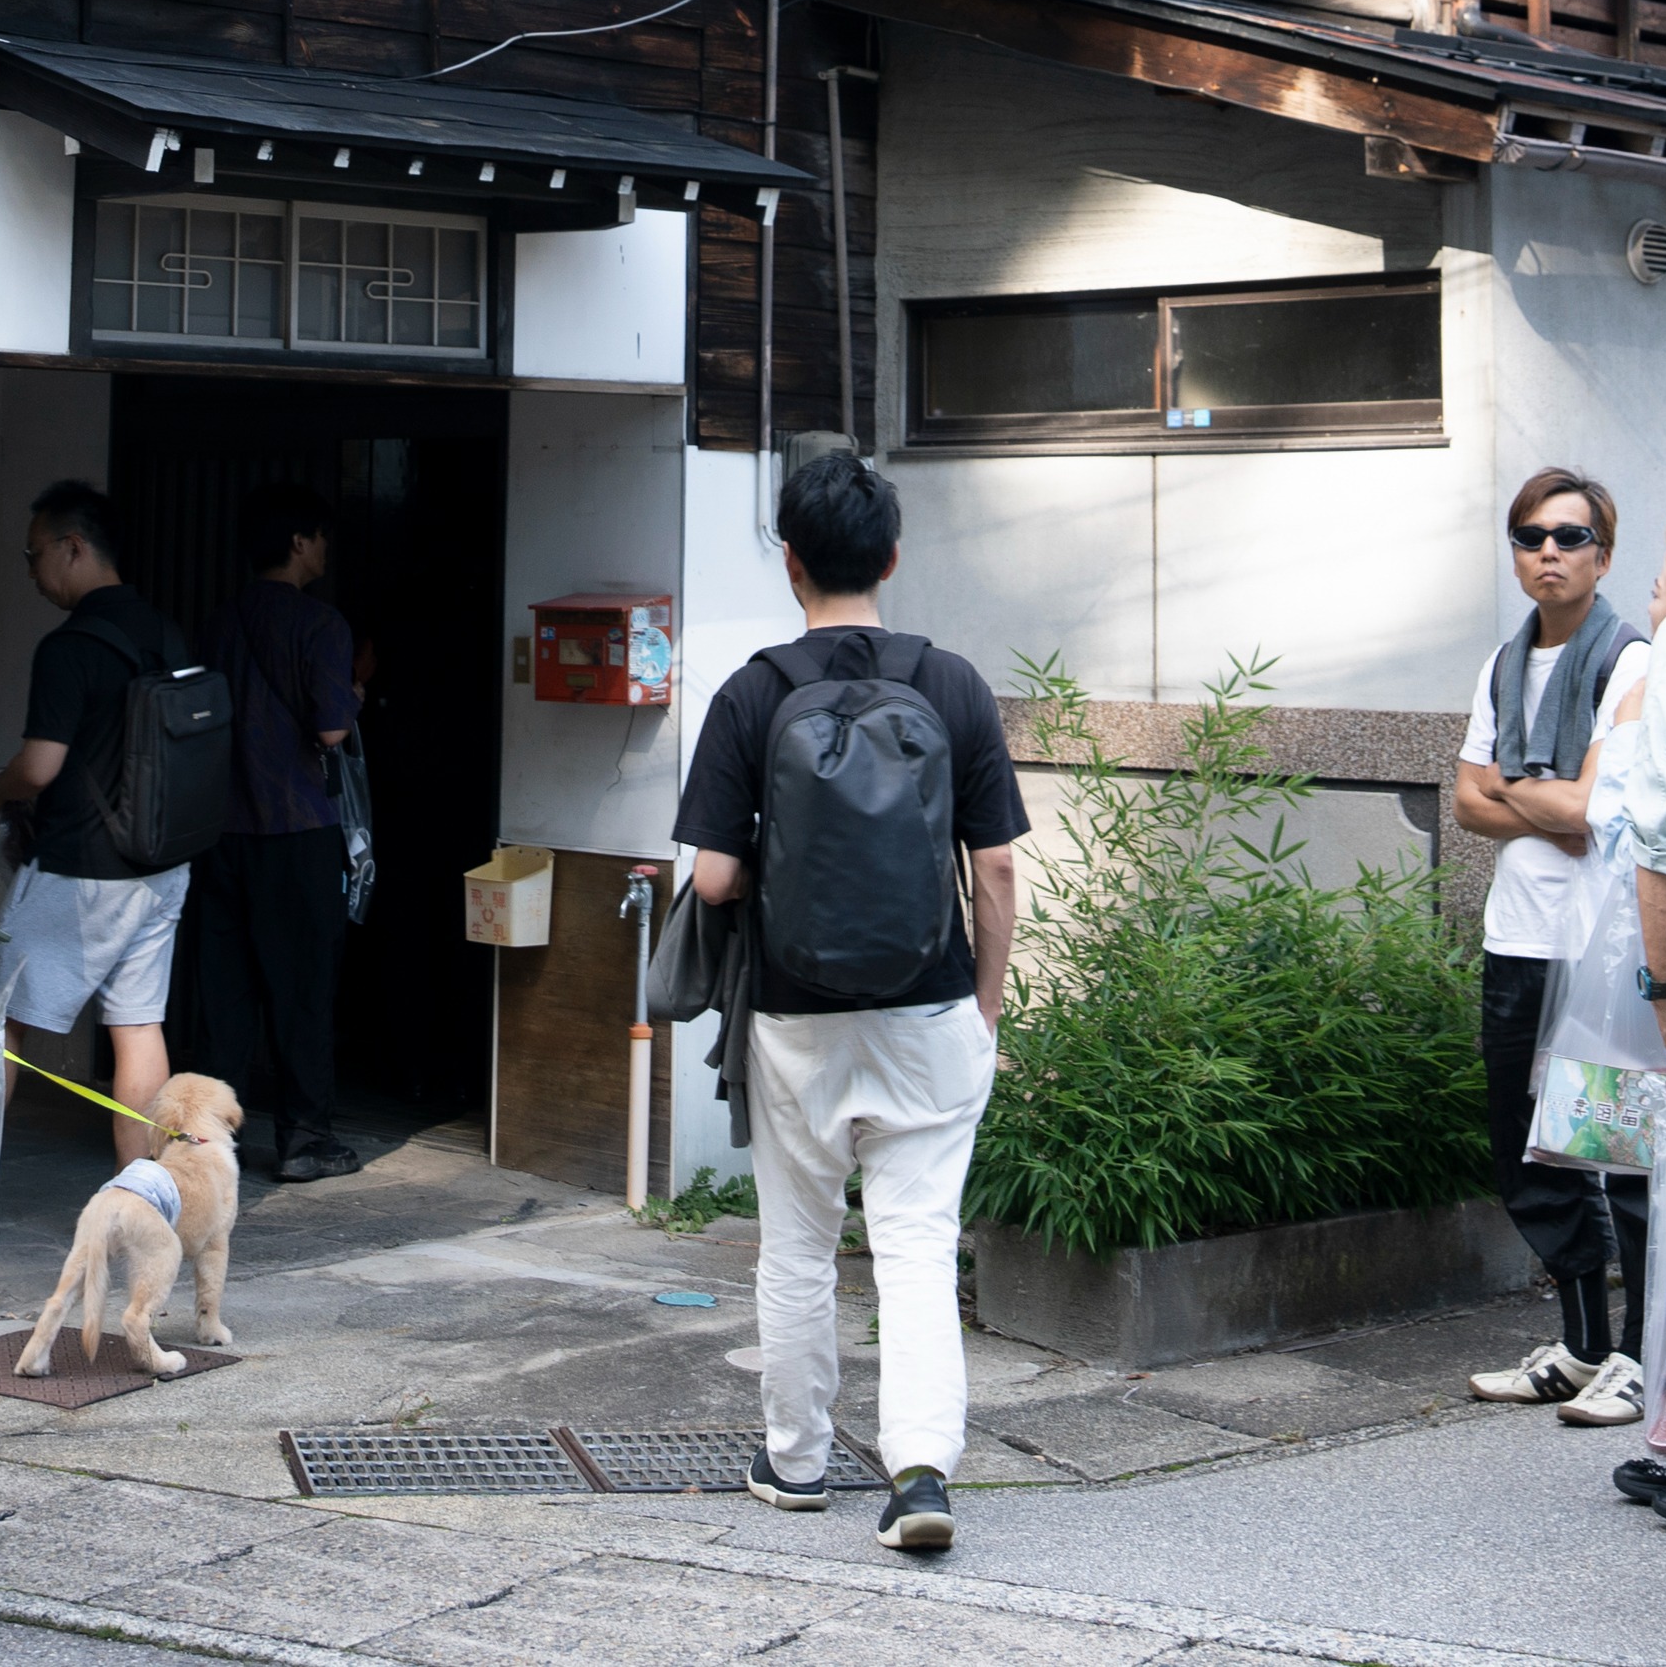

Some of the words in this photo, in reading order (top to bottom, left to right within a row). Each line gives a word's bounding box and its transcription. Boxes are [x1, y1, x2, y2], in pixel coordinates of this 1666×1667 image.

[471, 921, 507, 942] 牛乳
[1572, 1097, 1640, 1129] 神岡町
